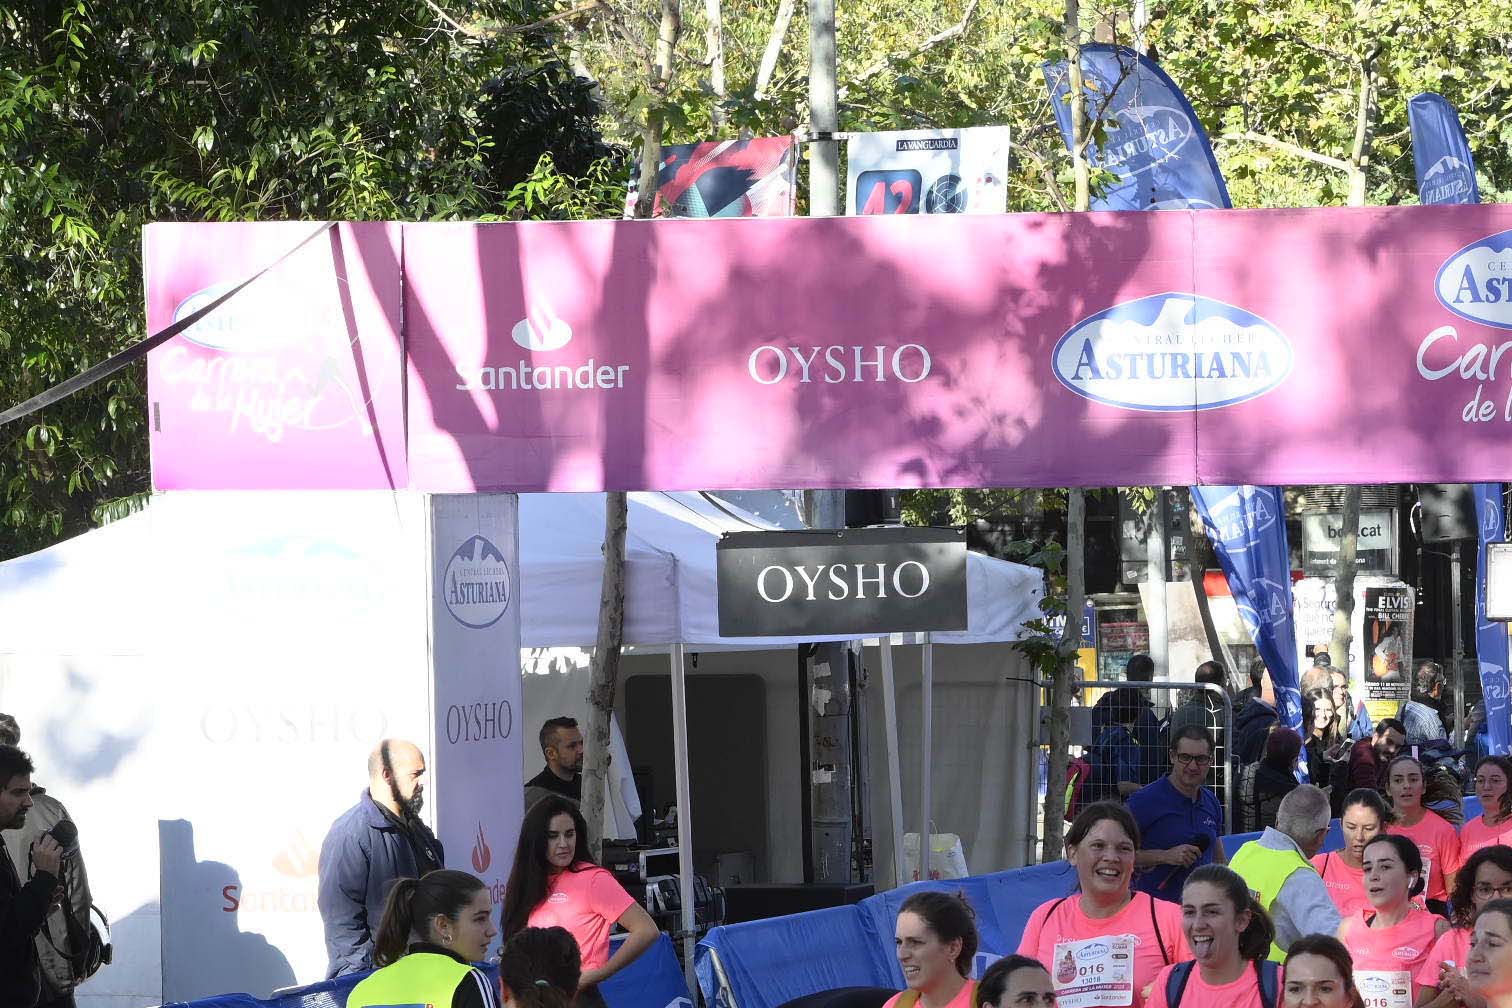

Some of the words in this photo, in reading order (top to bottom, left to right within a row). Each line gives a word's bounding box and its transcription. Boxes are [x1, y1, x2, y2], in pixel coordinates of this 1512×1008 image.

[455, 358, 629, 390] Santander
[748, 343, 932, 385] OYSHO
[1072, 337, 1272, 381] ASTURIANA
[1462, 386, 1497, 423] de
[449, 570, 507, 606] ASTURIANA
[757, 561, 931, 602] OYSHO
[1378, 596, 1409, 608] ELVIS
[446, 700, 512, 744] OYSHO
[1079, 964, 1104, 976] 016
[1364, 998, 1387, 1008] 016
